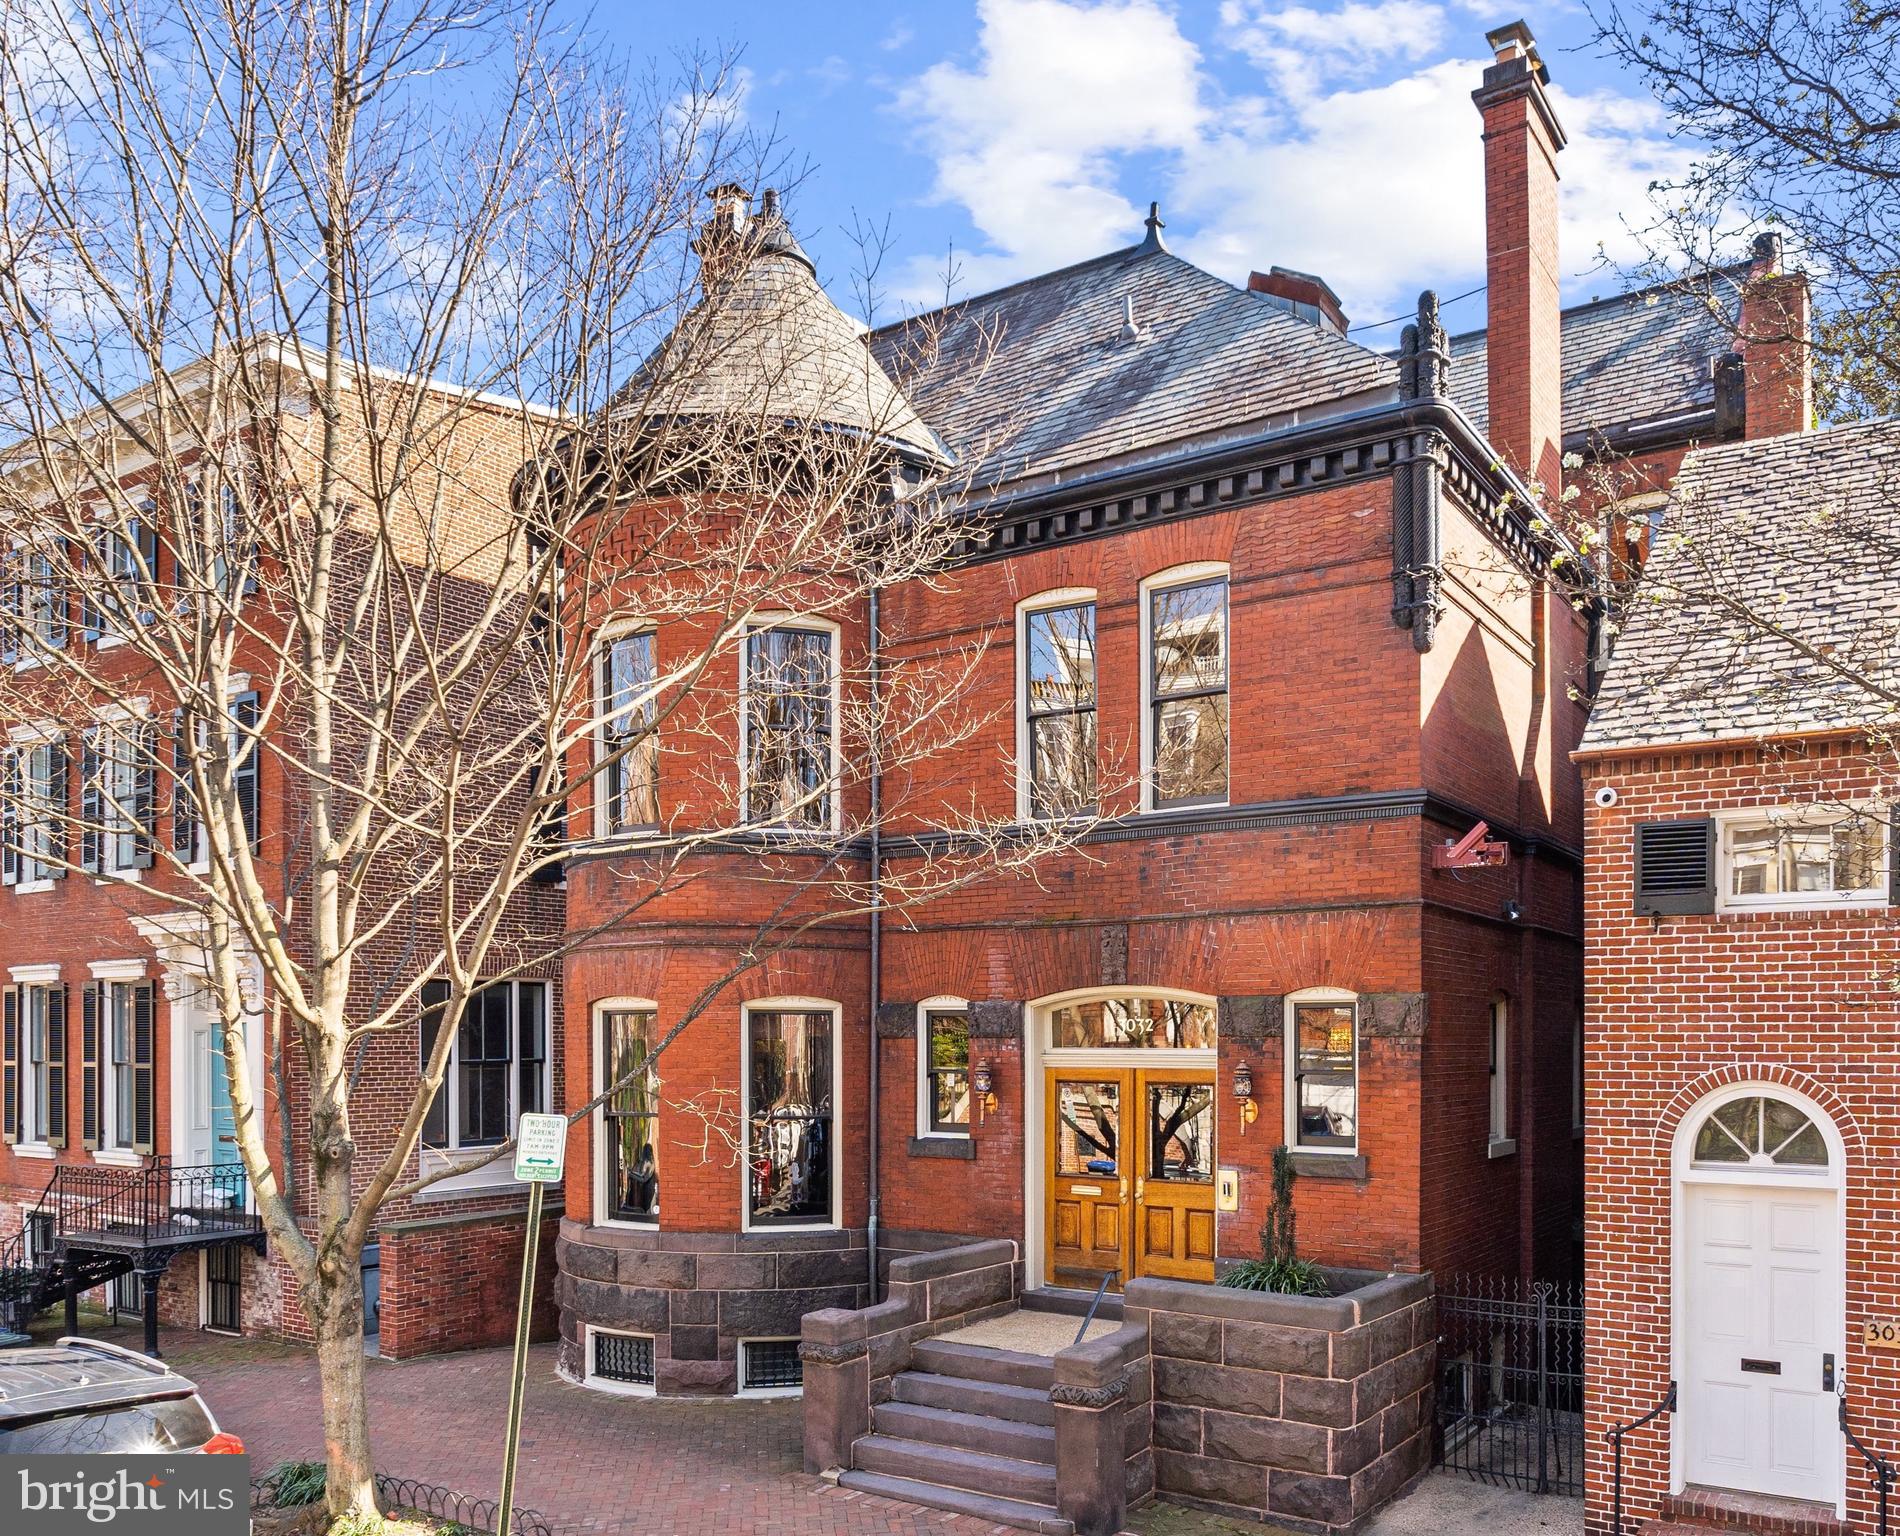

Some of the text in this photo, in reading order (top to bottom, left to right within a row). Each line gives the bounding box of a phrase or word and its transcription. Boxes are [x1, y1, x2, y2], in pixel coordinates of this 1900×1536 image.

[1118, 1018, 1154, 1035] 3032
[527, 1119, 561, 1129] TWO HOUR
[1867, 1323, 1900, 1344] 30
